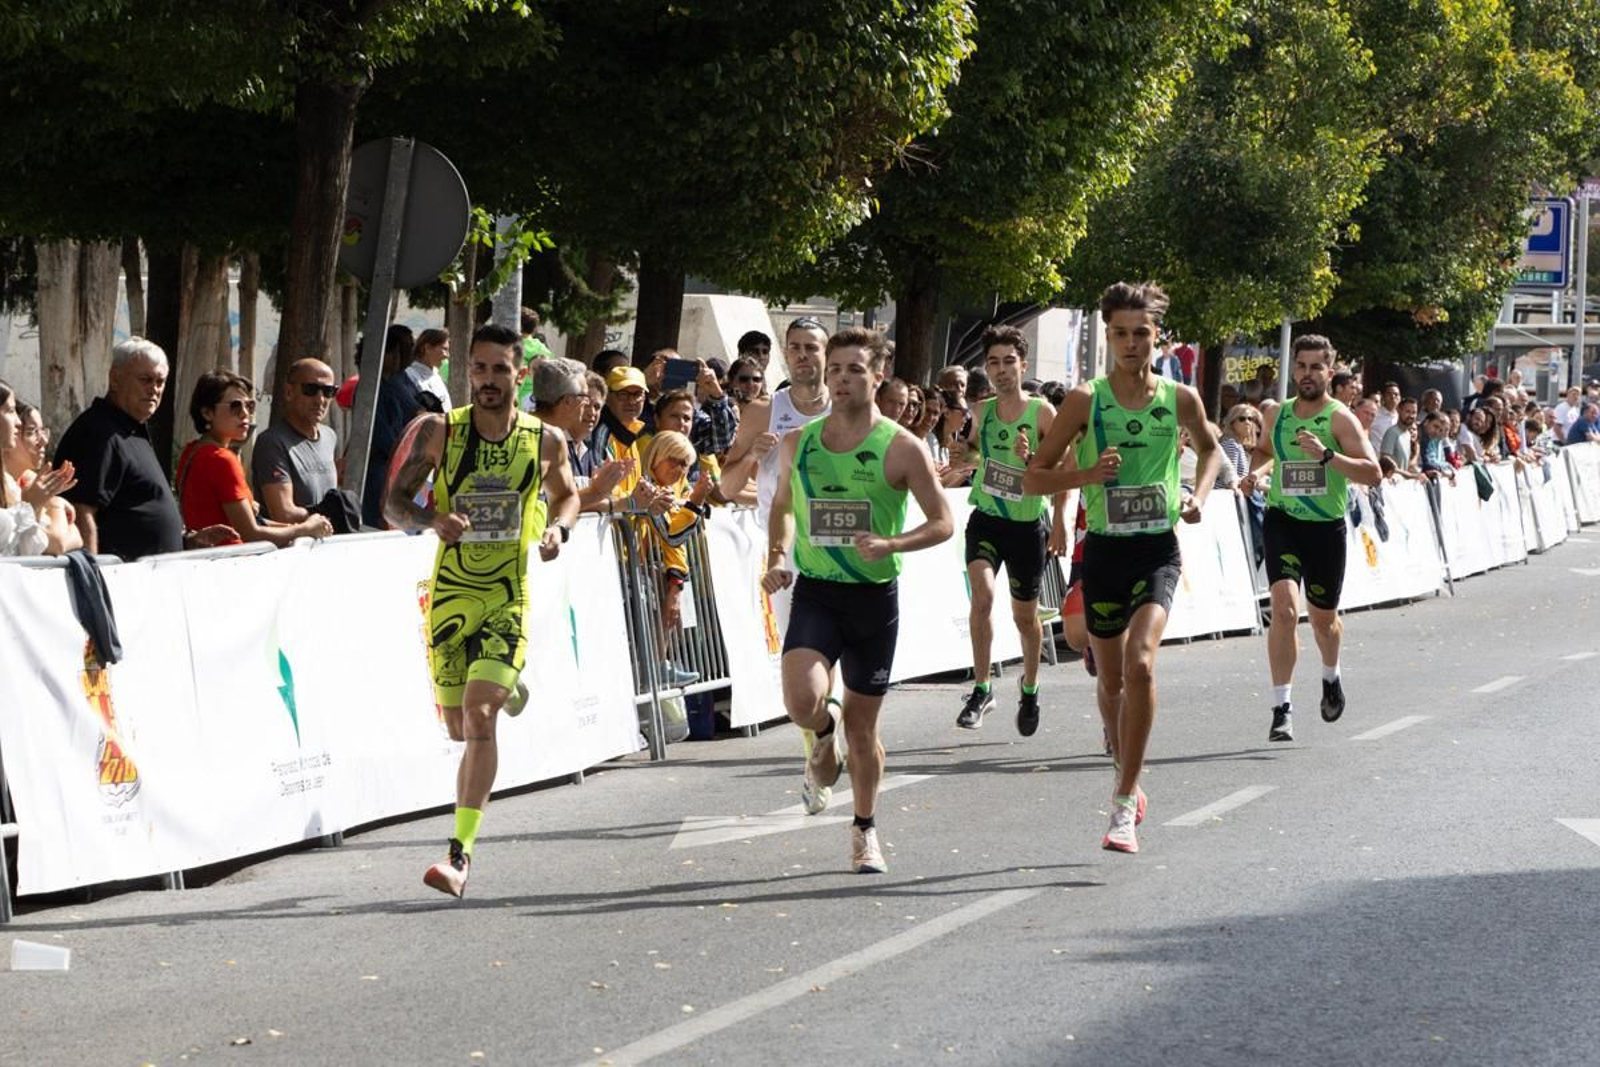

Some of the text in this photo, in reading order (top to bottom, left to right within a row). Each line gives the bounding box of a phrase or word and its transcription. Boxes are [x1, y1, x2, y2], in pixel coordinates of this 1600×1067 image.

[991, 471, 1014, 487] 158
[1290, 470, 1315, 482] 188
[1120, 497, 1153, 514] 100
[469, 506, 505, 522] 234
[822, 512, 857, 527] 159
